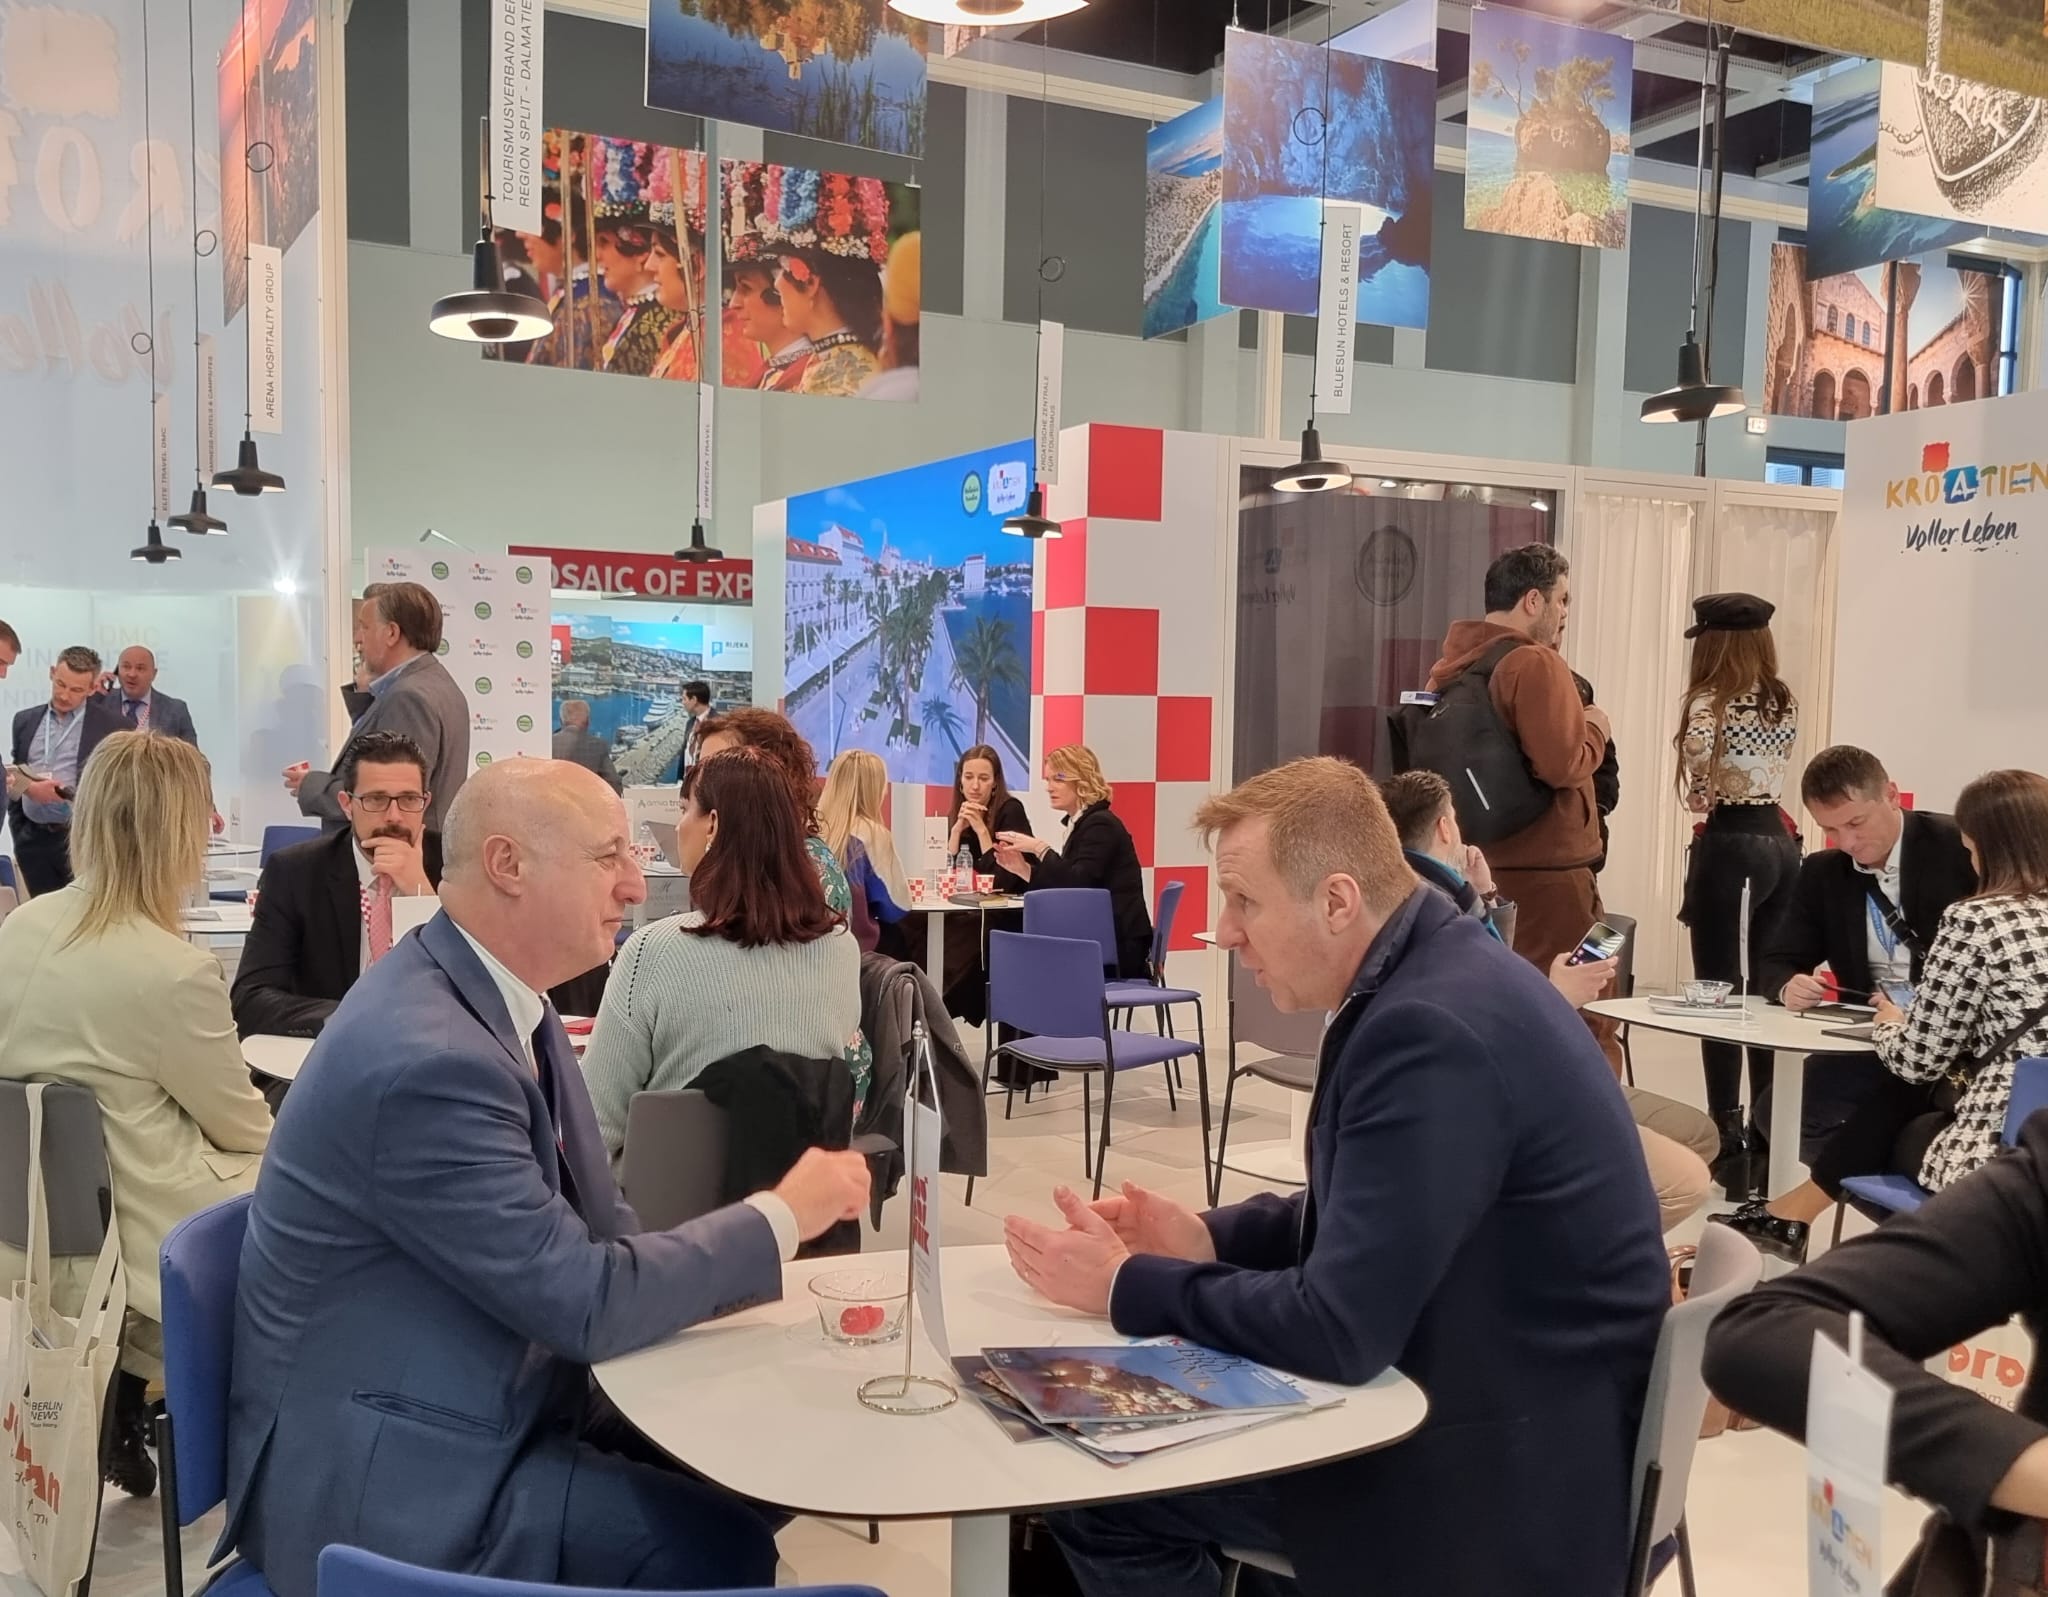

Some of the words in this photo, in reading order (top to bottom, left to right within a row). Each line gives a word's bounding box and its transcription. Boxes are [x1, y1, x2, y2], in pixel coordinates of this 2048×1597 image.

[502, 31, 516, 203] TOURISMUSVERBAND
[519, 96, 532, 142] SPLIT
[519, 146, 531, 207] REGION
[1341, 223, 1352, 272] RESORT
[265, 262, 275, 306] GROUP
[1340, 277, 1350, 285] &
[1337, 288, 1349, 336] HOTELS
[265, 307, 275, 380] HOSPITALITY
[1333, 340, 1346, 397] BLUESUN
[265, 382, 275, 418] ARENA
[1906, 518, 1960, 551] Voller
[1962, 511, 2020, 545] Leben
[644, 568, 687, 597] OF
[30, 1410, 59, 1421] NEWS
[31, 1400, 64, 1412] BERLIN
